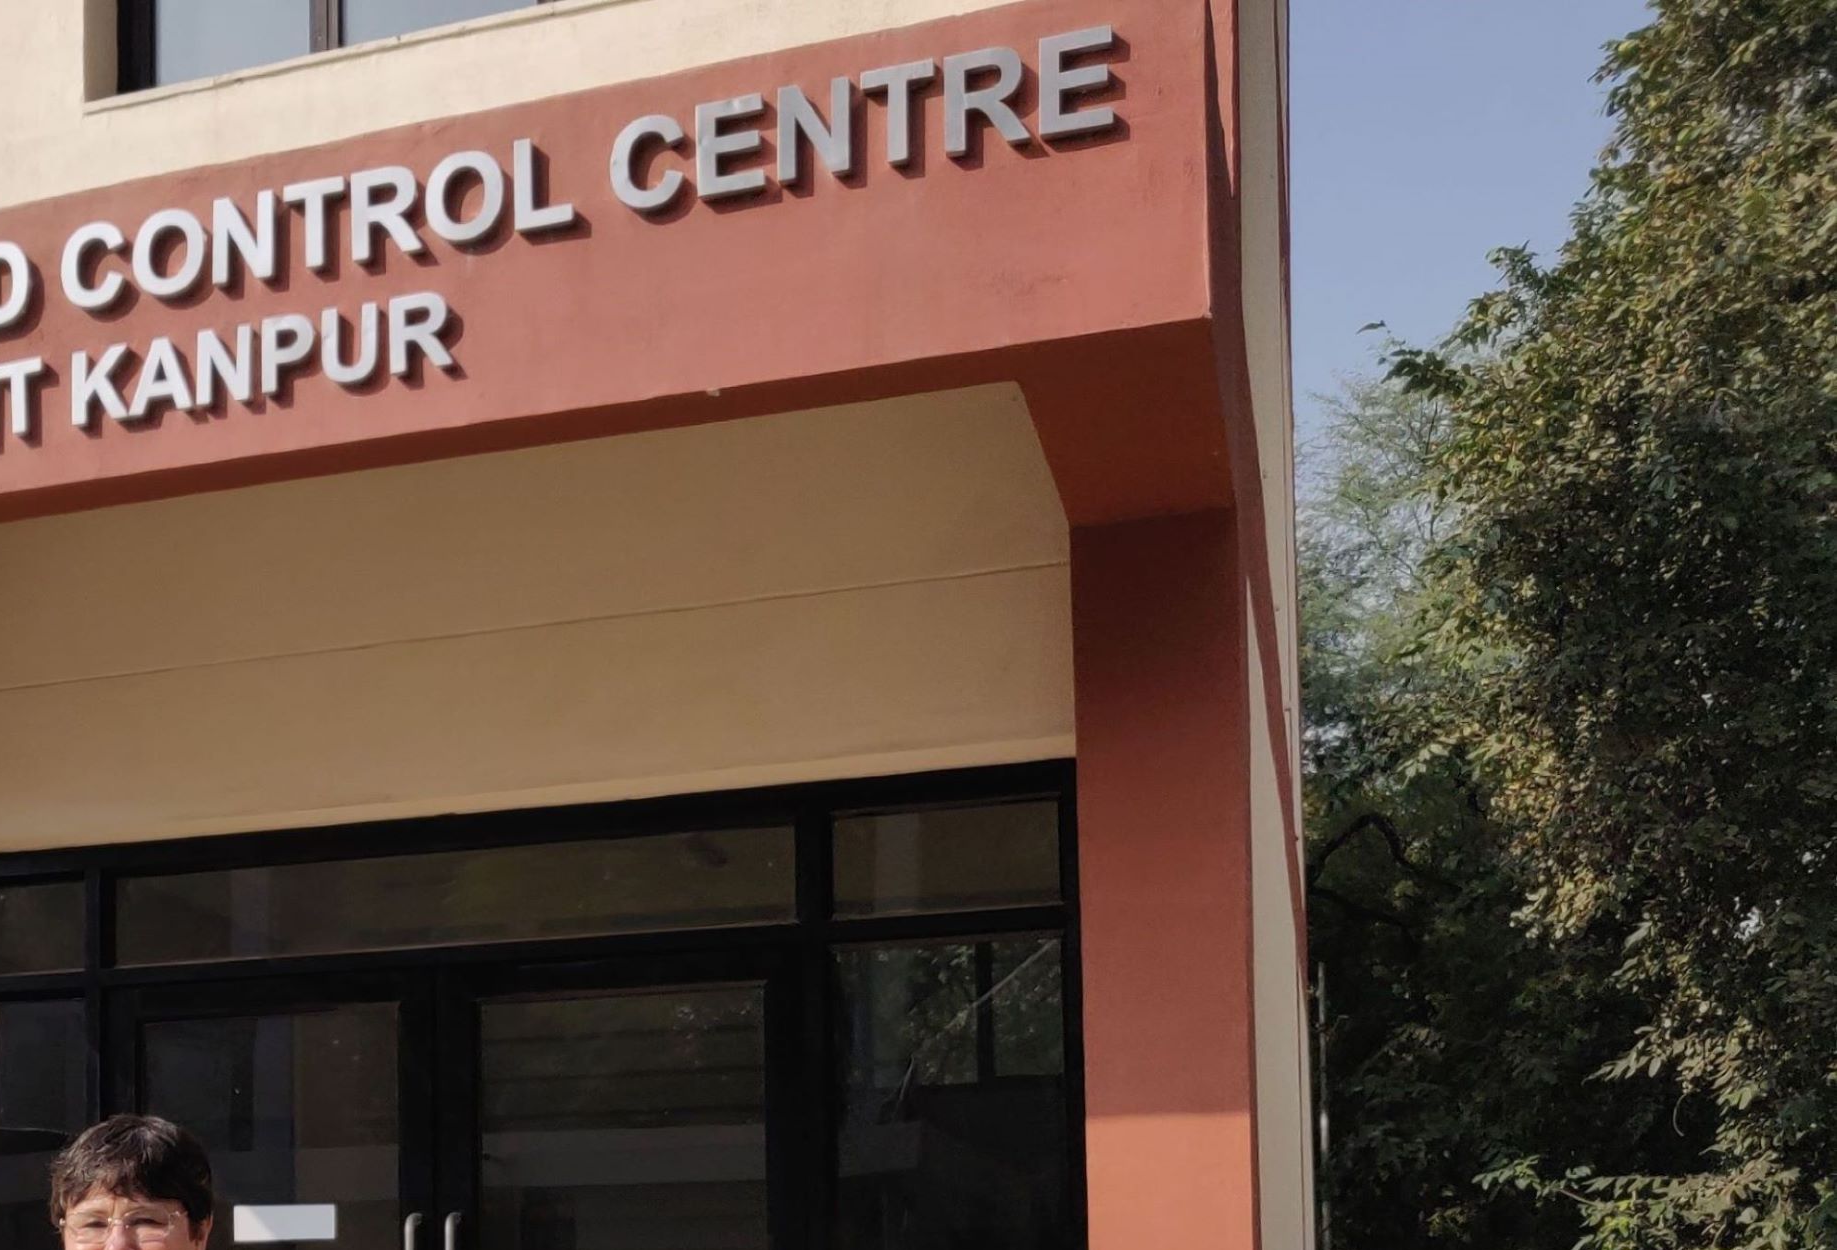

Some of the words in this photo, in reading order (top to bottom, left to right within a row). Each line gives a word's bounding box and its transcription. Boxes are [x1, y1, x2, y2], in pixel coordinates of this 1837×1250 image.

[60, 138, 576, 310] CONTROL
[609, 24, 1115, 211] CENTRE
[70, 290, 454, 428] KANPUR
